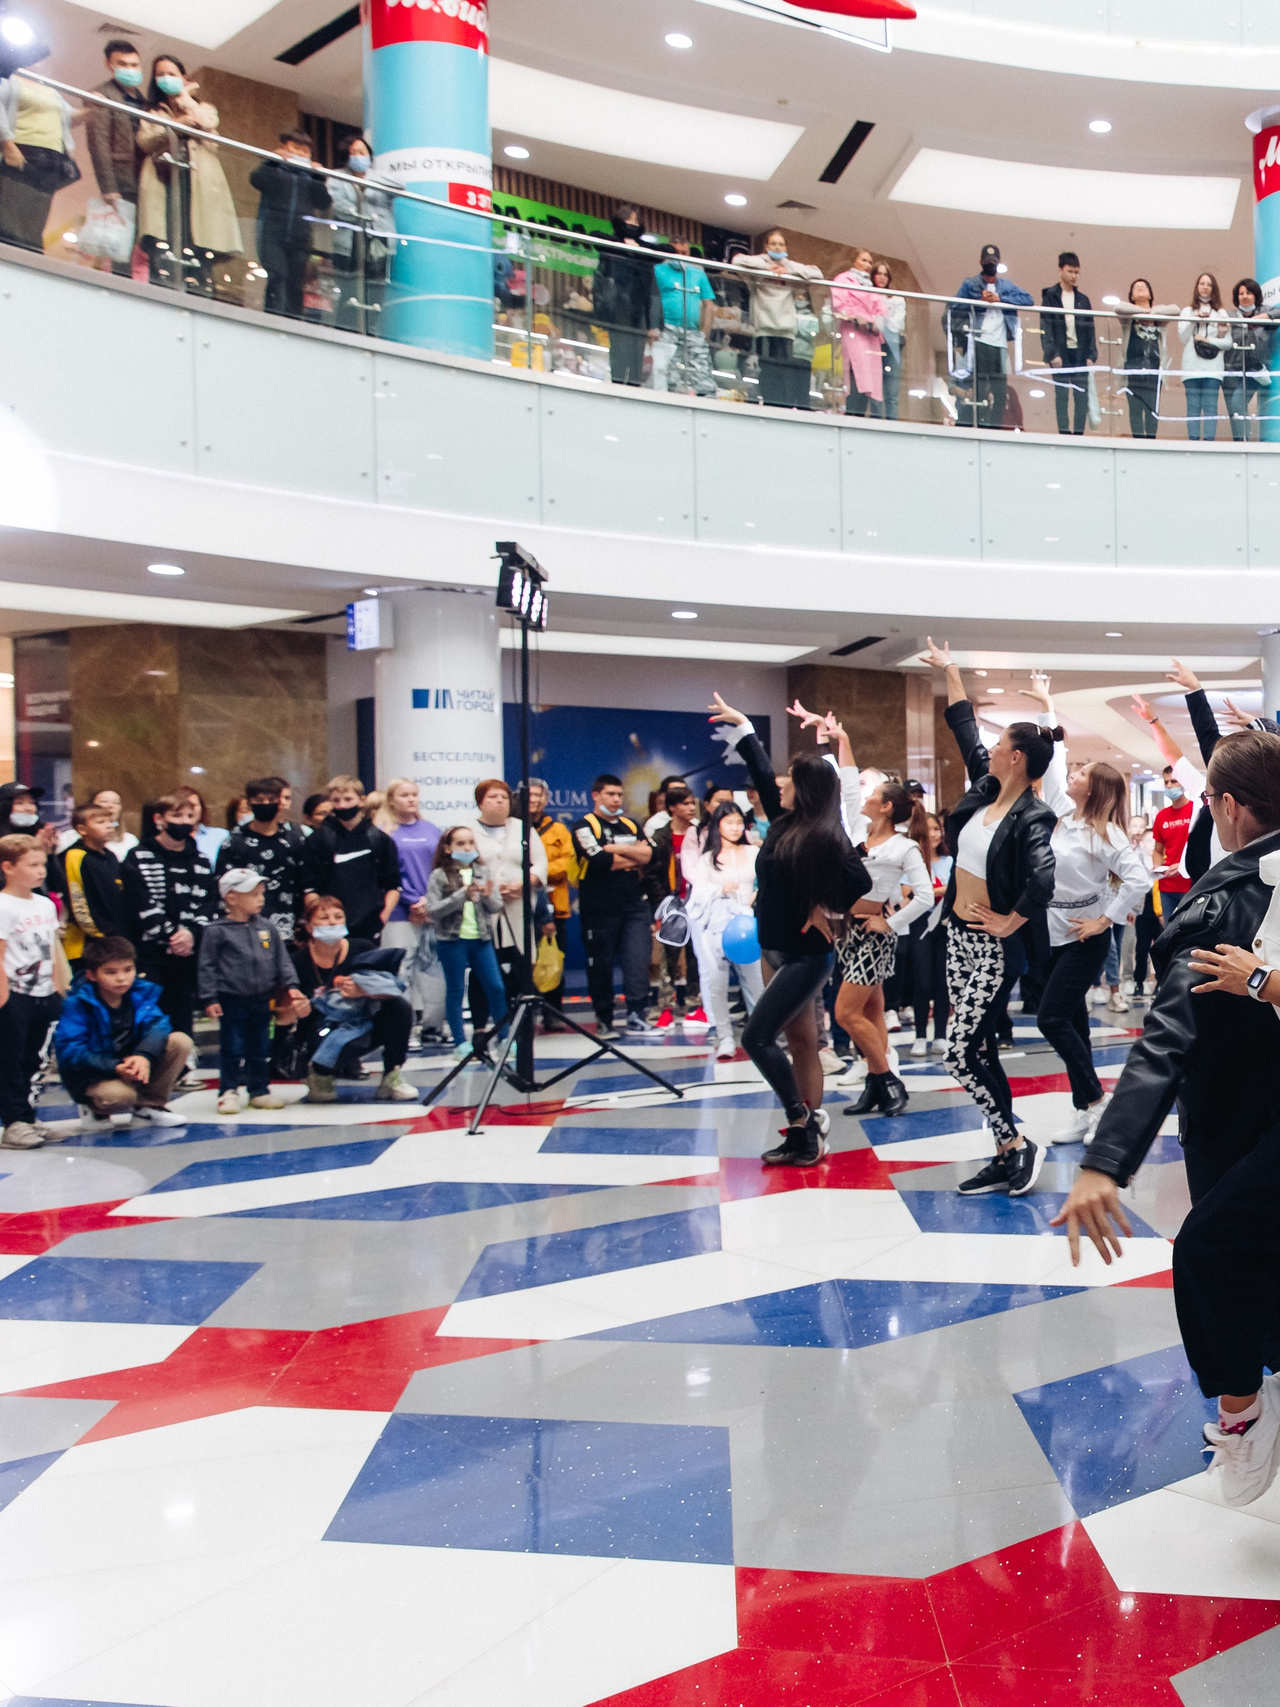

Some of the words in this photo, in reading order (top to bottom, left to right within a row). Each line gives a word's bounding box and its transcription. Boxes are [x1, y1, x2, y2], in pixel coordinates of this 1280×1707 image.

[389, 161, 417, 171] МЫ
[456, 700, 494, 712] ГОРОД
[546, 789, 589, 807] RUM
